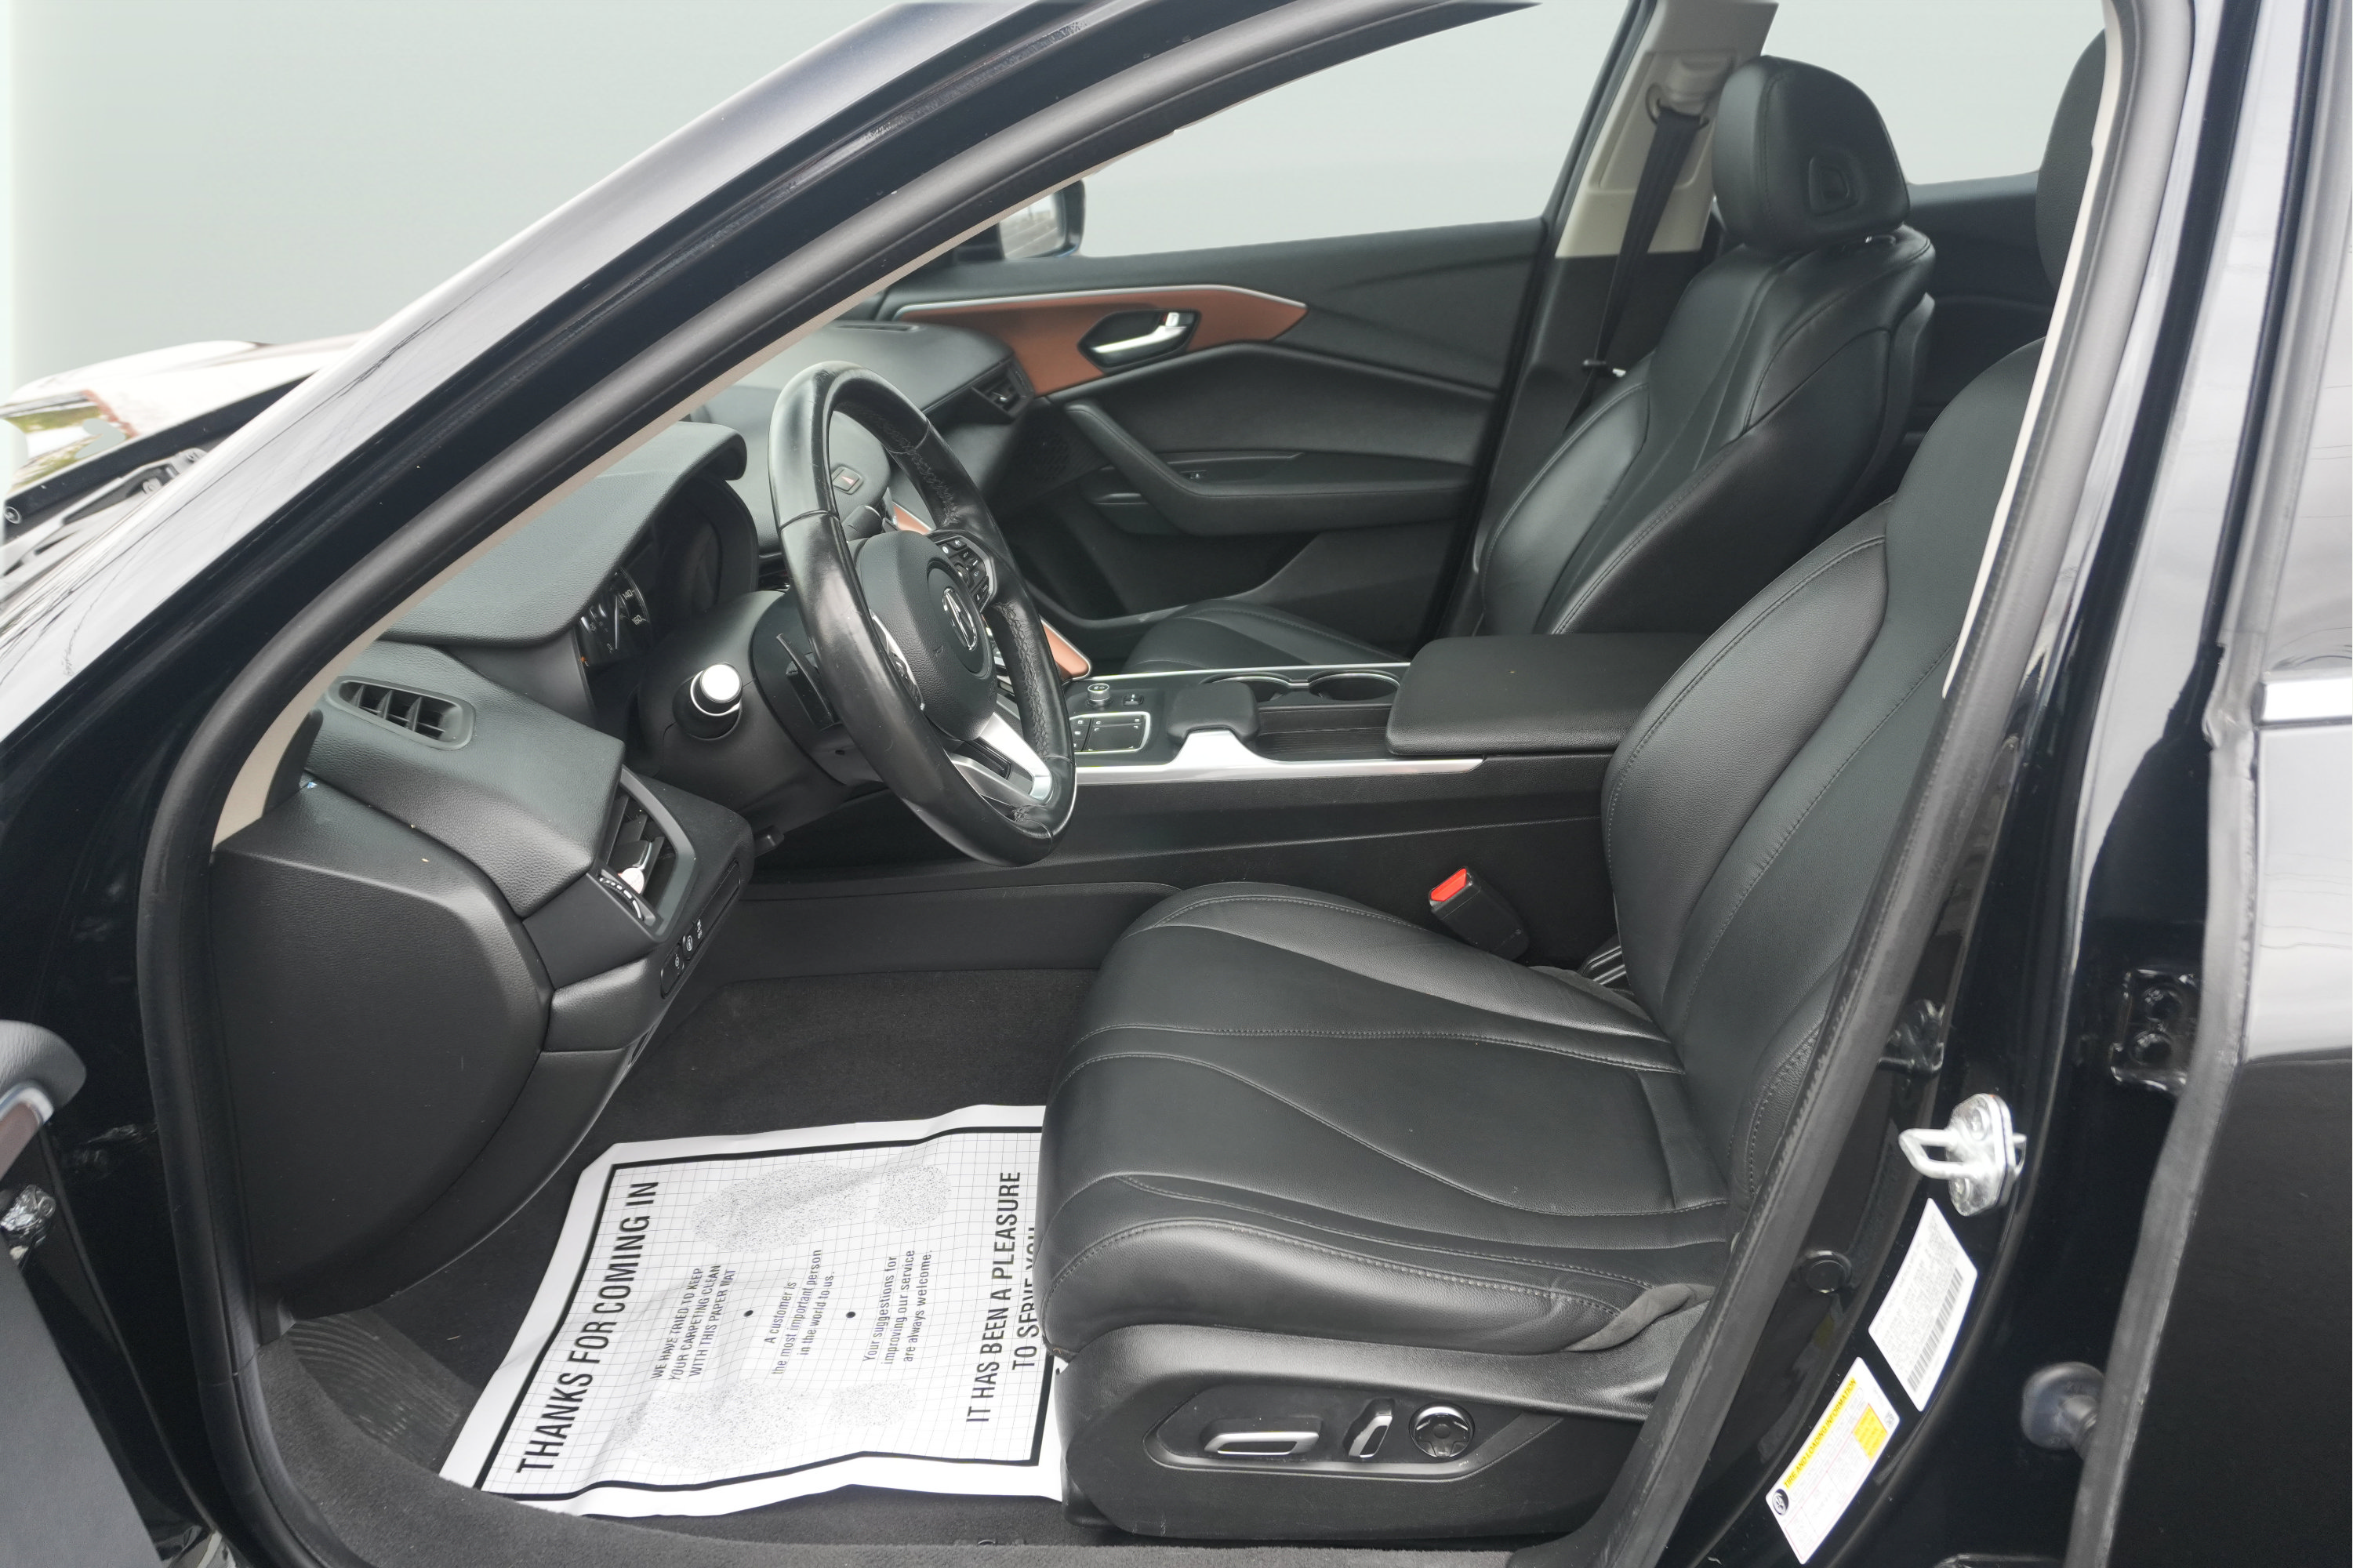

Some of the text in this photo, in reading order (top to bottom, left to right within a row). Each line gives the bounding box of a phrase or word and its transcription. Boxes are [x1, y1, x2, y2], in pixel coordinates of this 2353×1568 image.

[622, 590, 633, 600] 140
[632, 615, 642, 626] 160
[516, 1181, 659, 1473] THANKS FOR COMING IN
[650, 1268, 704, 1380] WE HAVE TRIED TO KEEP
[668, 1265, 721, 1380] YOUR CARPETING CLEAN
[688, 1269, 736, 1377] WITH THIS PAPER MAT
[769, 1291, 793, 1334] customer
[771, 1250, 822, 1374] the most important person
[801, 1329, 816, 1344] the
[810, 1301, 826, 1327] world
[818, 1290, 830, 1299] to
[862, 1256, 897, 1362] Your suggestions for
[881, 1250, 915, 1365] improving our service
[903, 1250, 932, 1363] are always welcome.
[966, 1172, 1021, 1423] IT HAS BEEN A PLEASURE
[797, 1345, 811, 1356] in
[1011, 1345, 1037, 1370] TO
[1784, 1377, 1857, 1489] TIRE AND LOADING INFORMATION
